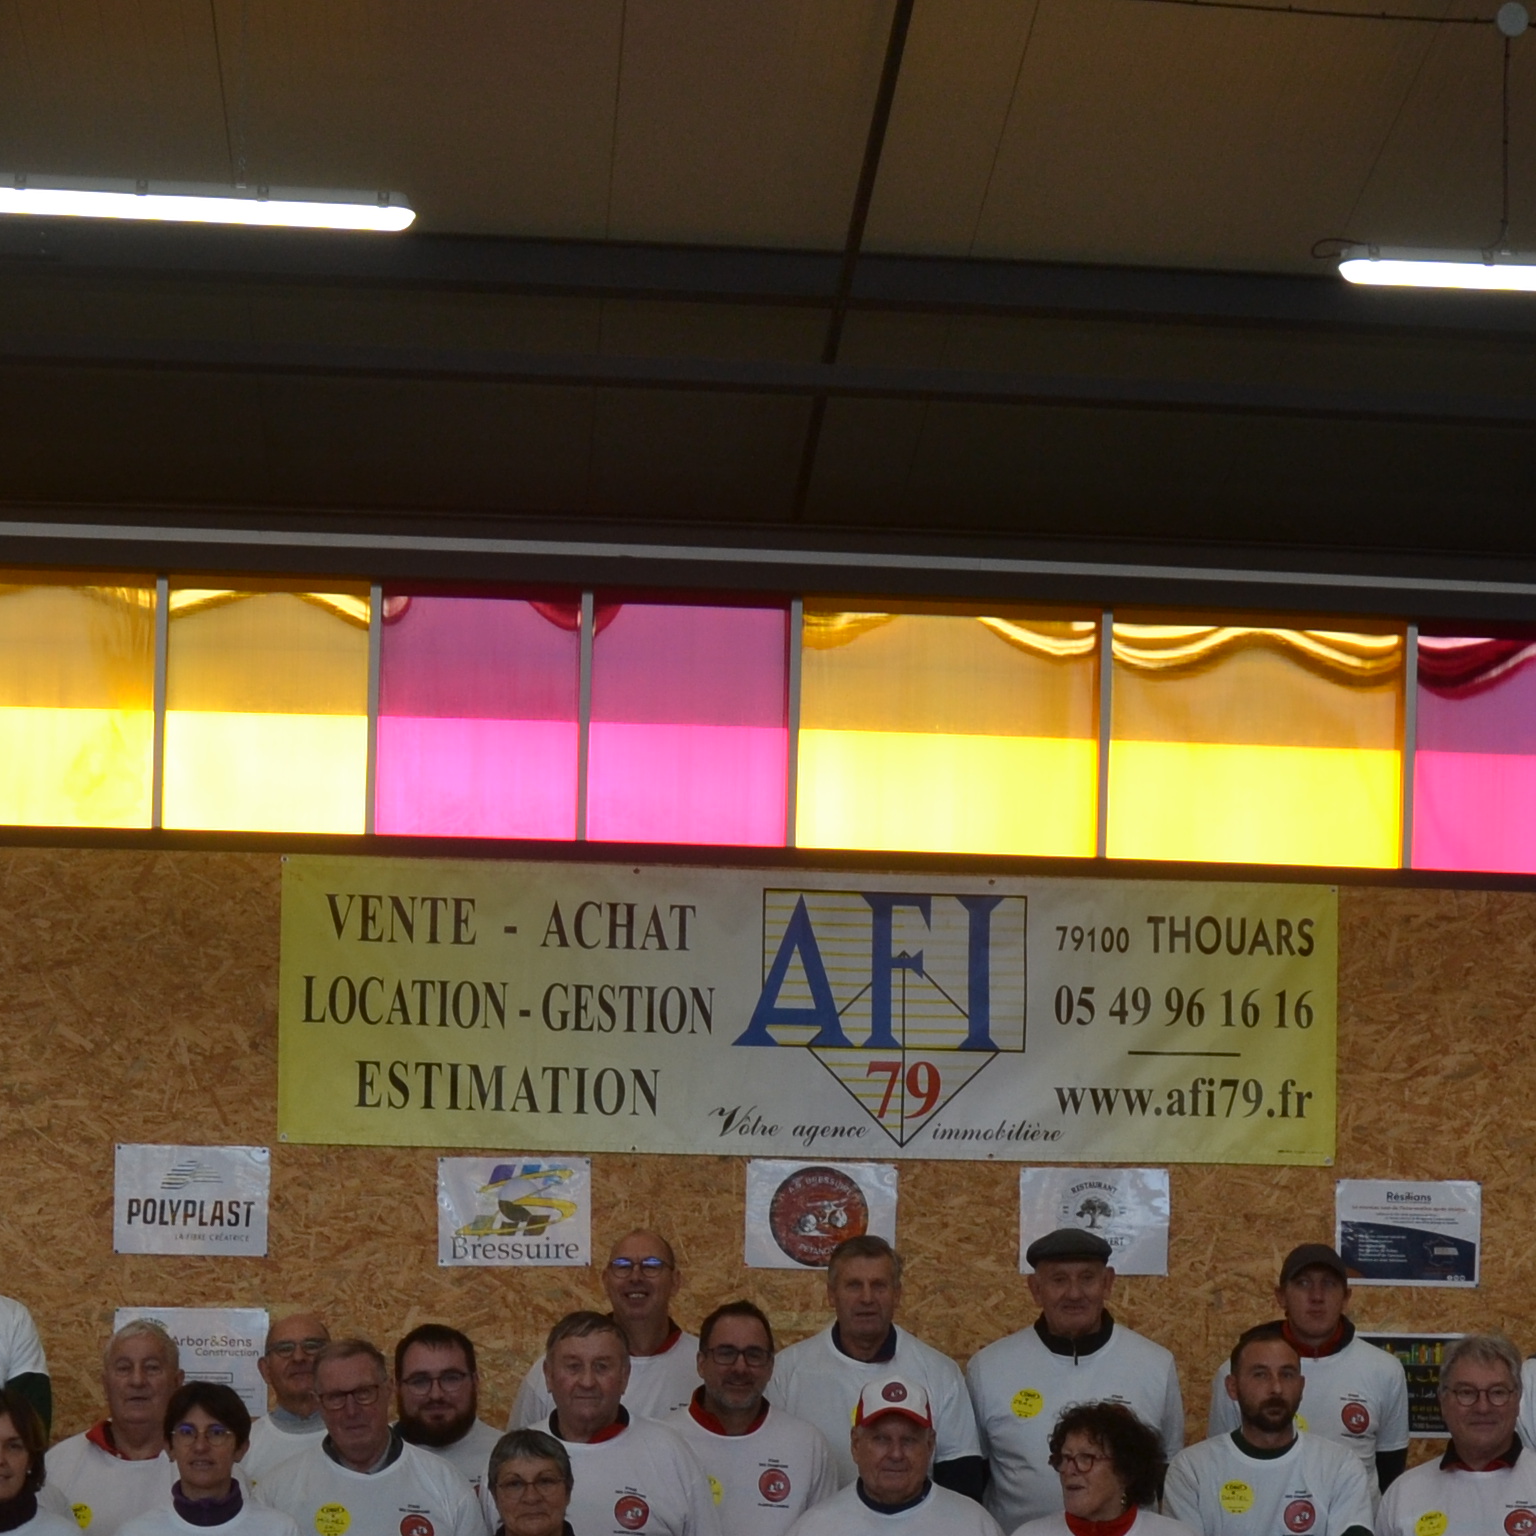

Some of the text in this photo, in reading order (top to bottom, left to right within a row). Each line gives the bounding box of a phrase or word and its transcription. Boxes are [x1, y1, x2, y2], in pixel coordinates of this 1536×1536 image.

[326, 893, 477, 946] VENTE
[540, 899, 697, 951] ACHAT
[1055, 914, 1316, 958] 79100 THOUARS
[731, 892, 1005, 1052] AFI
[302, 974, 509, 1030] LOCATION
[541, 982, 716, 1035] GESTION
[1054, 984, 1314, 1030] 05 49 96 16 16
[355, 1059, 662, 1117] ESTIMATION
[865, 1060, 942, 1121] 79
[1054, 1077, 1314, 1122] www.afi79.fr
[792, 1125, 870, 1148] agence
[931, 1119, 1066, 1143] immobilière
[1071, 1181, 1118, 1194] RESTAURANT
[127, 1197, 256, 1228] POLYPLAST
[450, 1236, 580, 1261] Bressuire
[173, 1335, 252, 1347] Arbor&Sens
[195, 1347, 260, 1357] Construction
